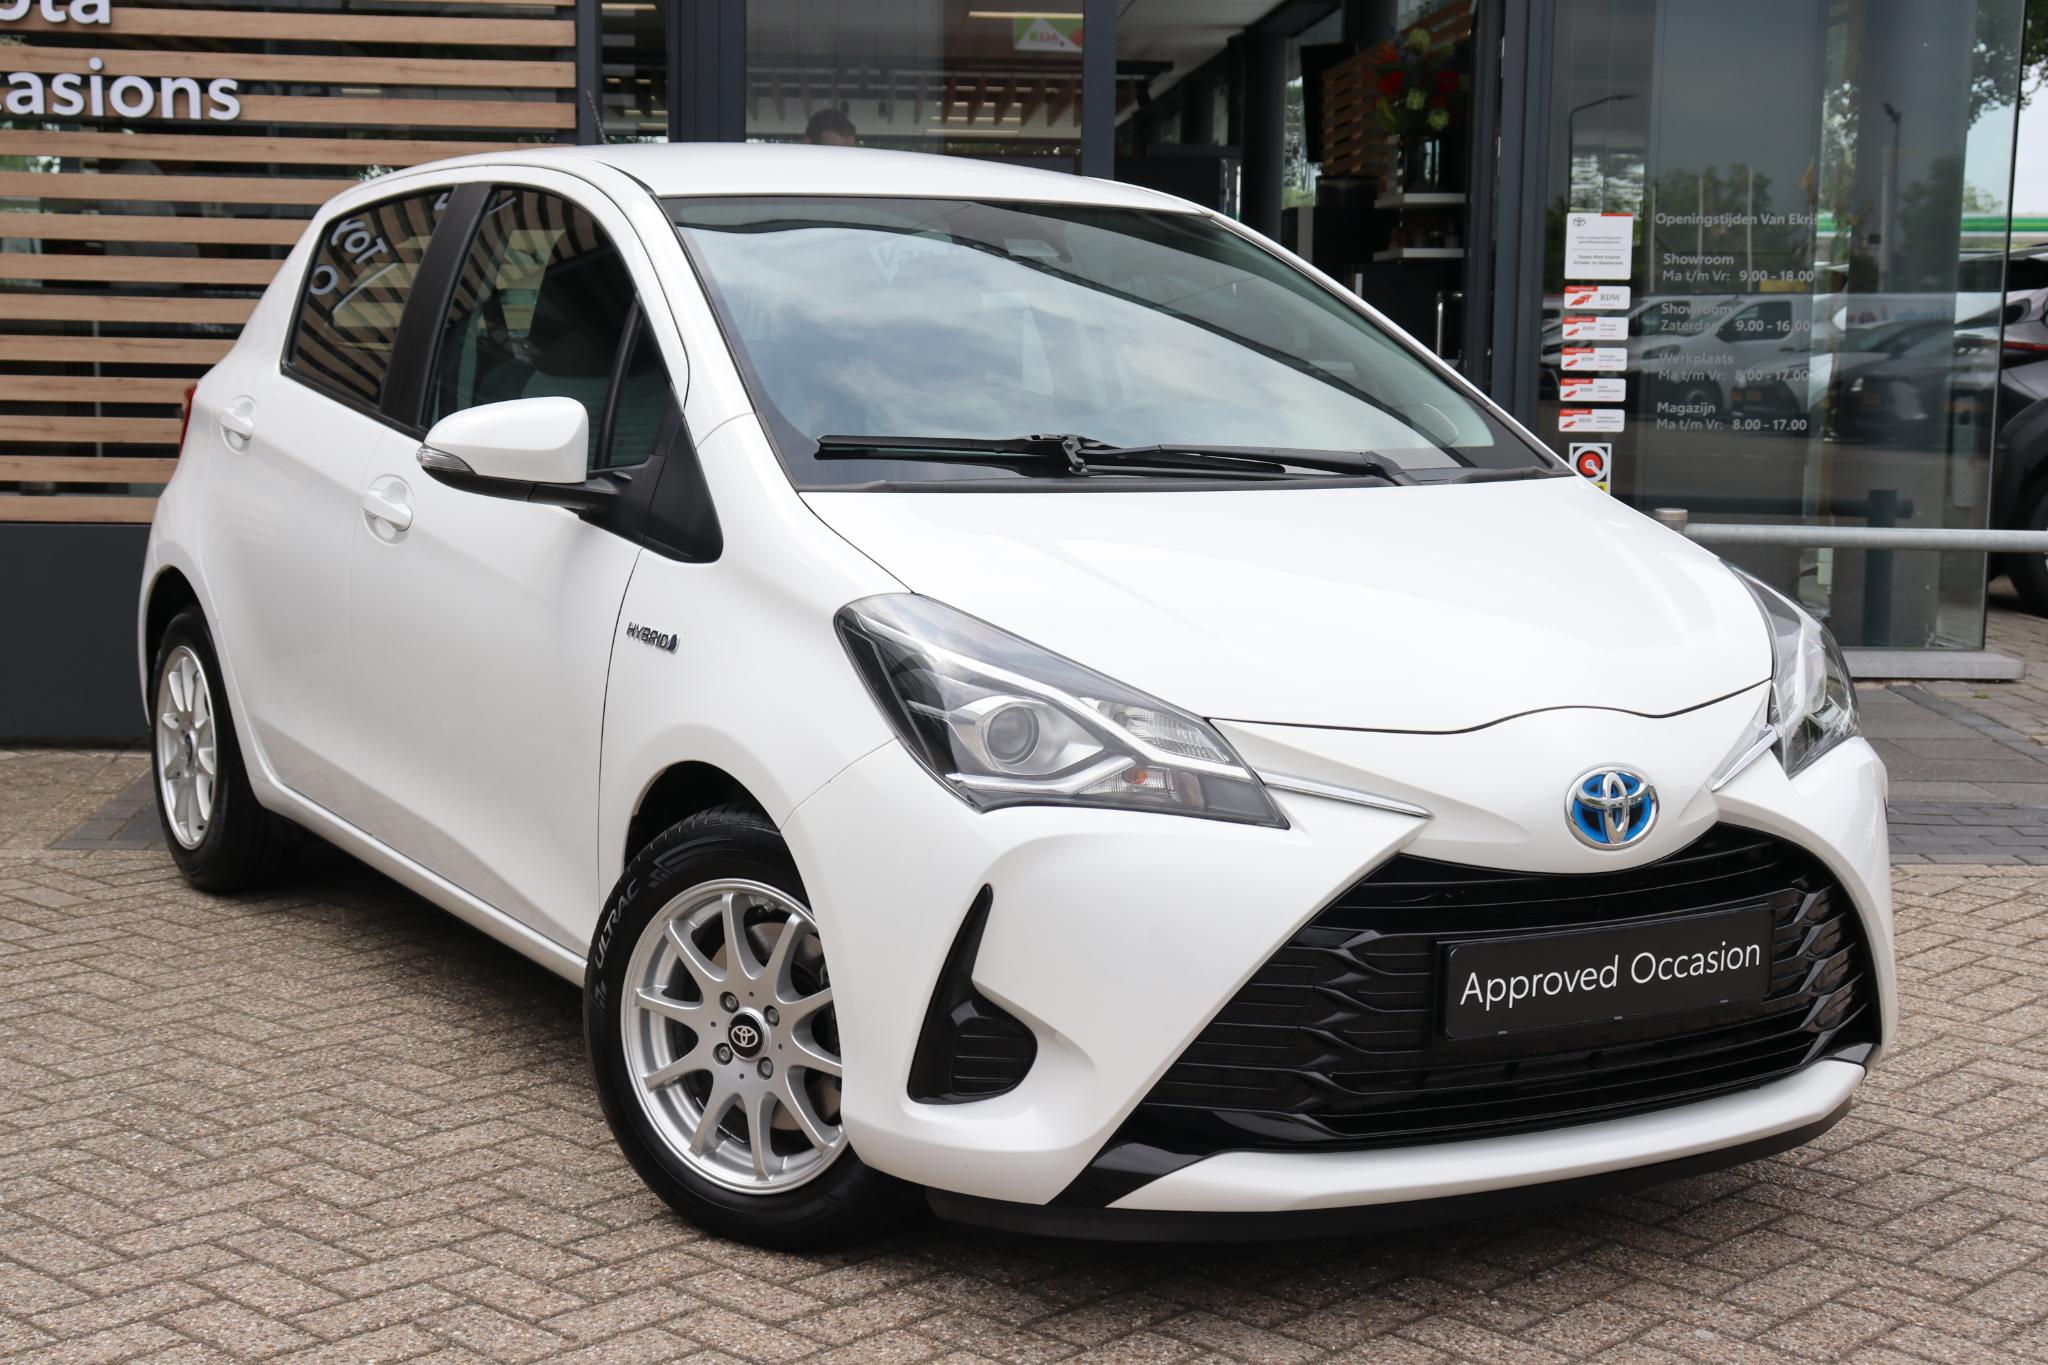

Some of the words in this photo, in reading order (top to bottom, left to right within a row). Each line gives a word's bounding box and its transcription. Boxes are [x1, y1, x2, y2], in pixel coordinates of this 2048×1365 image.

[0, 57, 241, 121] asions
[1655, 213, 1757, 227] Openingstijden
[1760, 214, 1784, 225] Van
[1663, 253, 1734, 265] Showroom
[1662, 271, 1682, 281] Ma
[1686, 270, 1709, 282] t/m
[1713, 271, 1730, 281] Vr:
[1740, 270, 1767, 282] 9.00
[1781, 270, 1814, 282] 18.00
[1661, 303, 1732, 314] Showroom
[1735, 320, 1764, 331] 9.00
[1776, 320, 1810, 331] 16.00
[1659, 353, 1734, 366] Werkplaats
[1658, 370, 1680, 380] Ma
[1681, 370, 1704, 382] t/m
[1775, 370, 1809, 381] 17.00
[1656, 402, 1716, 416] Magazijn
[1656, 420, 1676, 430] Ma
[1679, 419, 1702, 431] t/m
[1705, 420, 1723, 430] Vr:
[1732, 419, 1761, 430] 8.00
[1773, 419, 1807, 430] 17.00
[626, 621, 669, 649] HYBRID
[594, 877, 640, 970] ULTRAC
[1459, 954, 1619, 1012] Approved
[1630, 940, 1761, 984] Occasion
